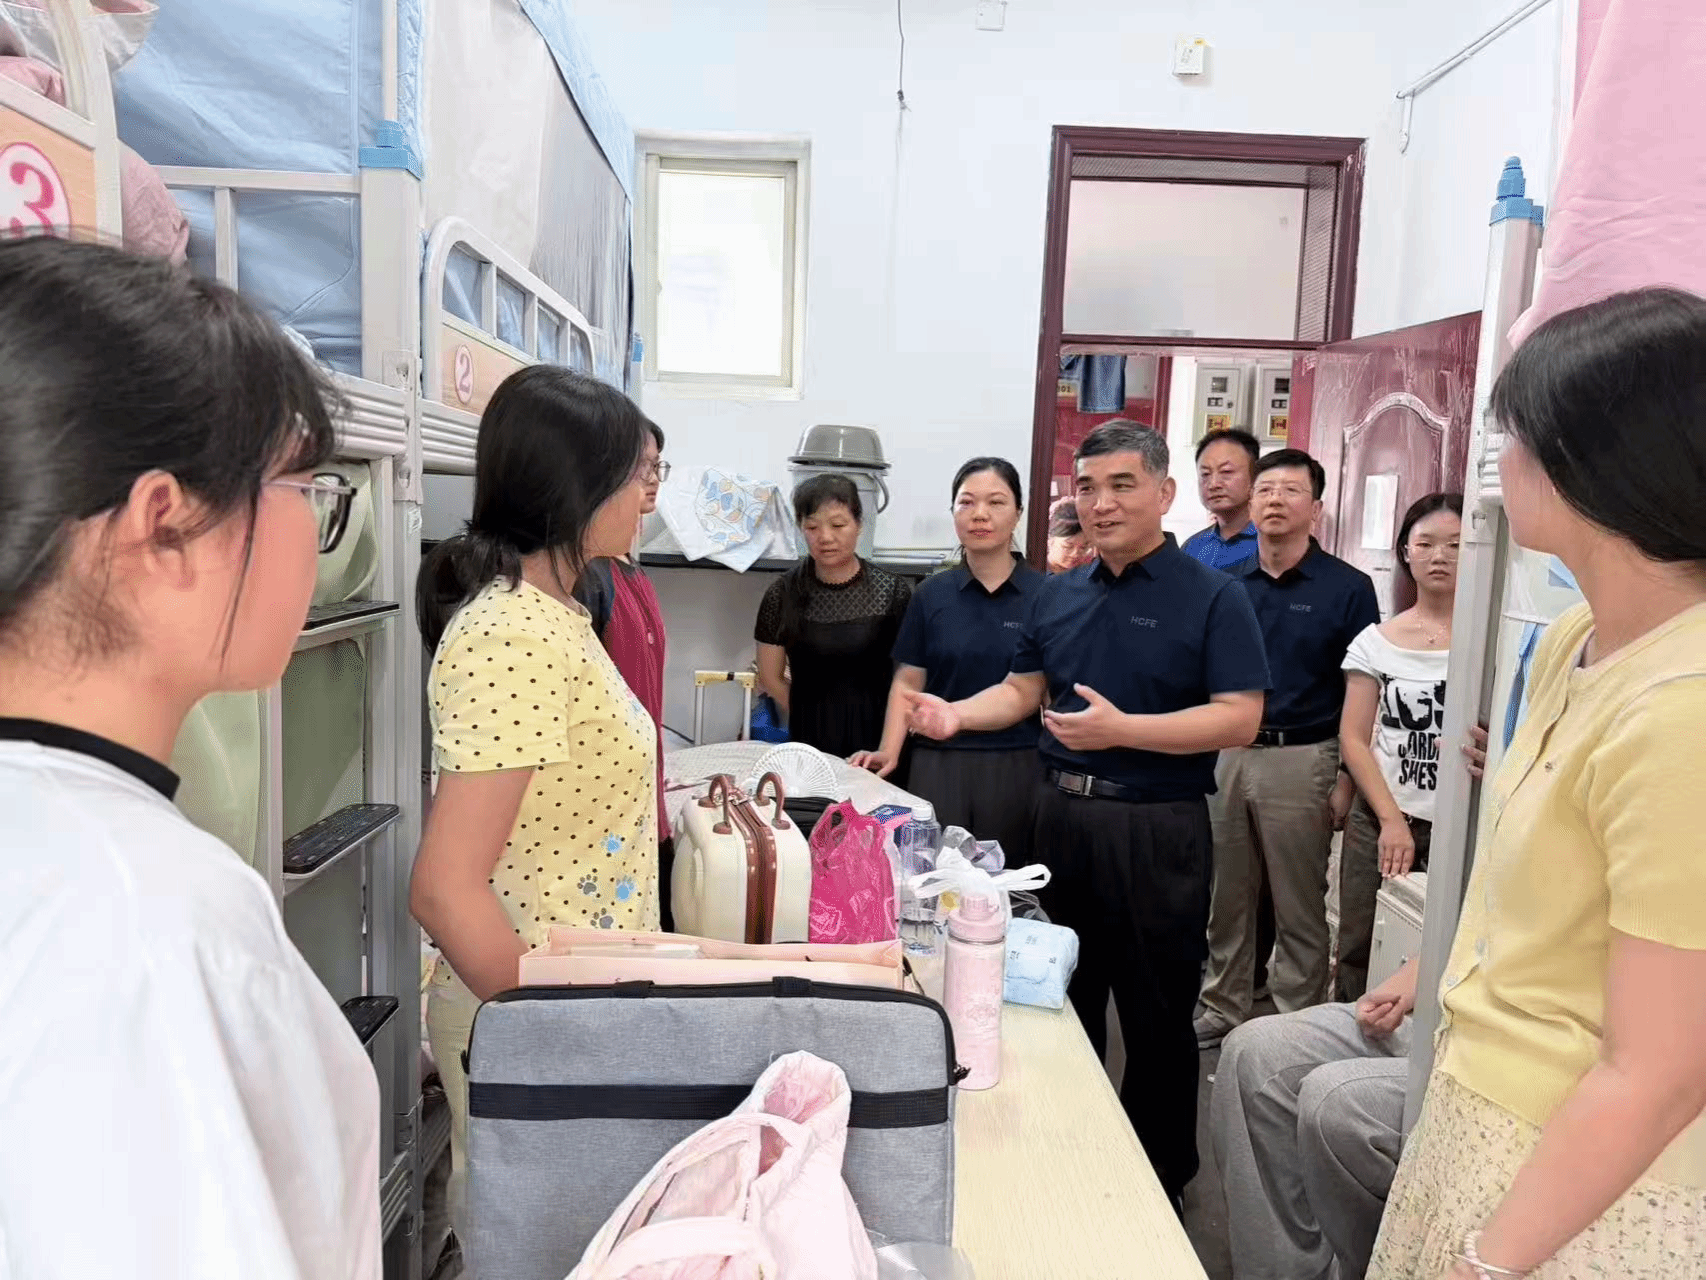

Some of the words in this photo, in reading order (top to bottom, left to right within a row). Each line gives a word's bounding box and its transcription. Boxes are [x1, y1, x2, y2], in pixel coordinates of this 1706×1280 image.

[10, 162, 55, 237] 3
[459, 354, 471, 393] 2
[1130, 616, 1158, 628] HCFE
